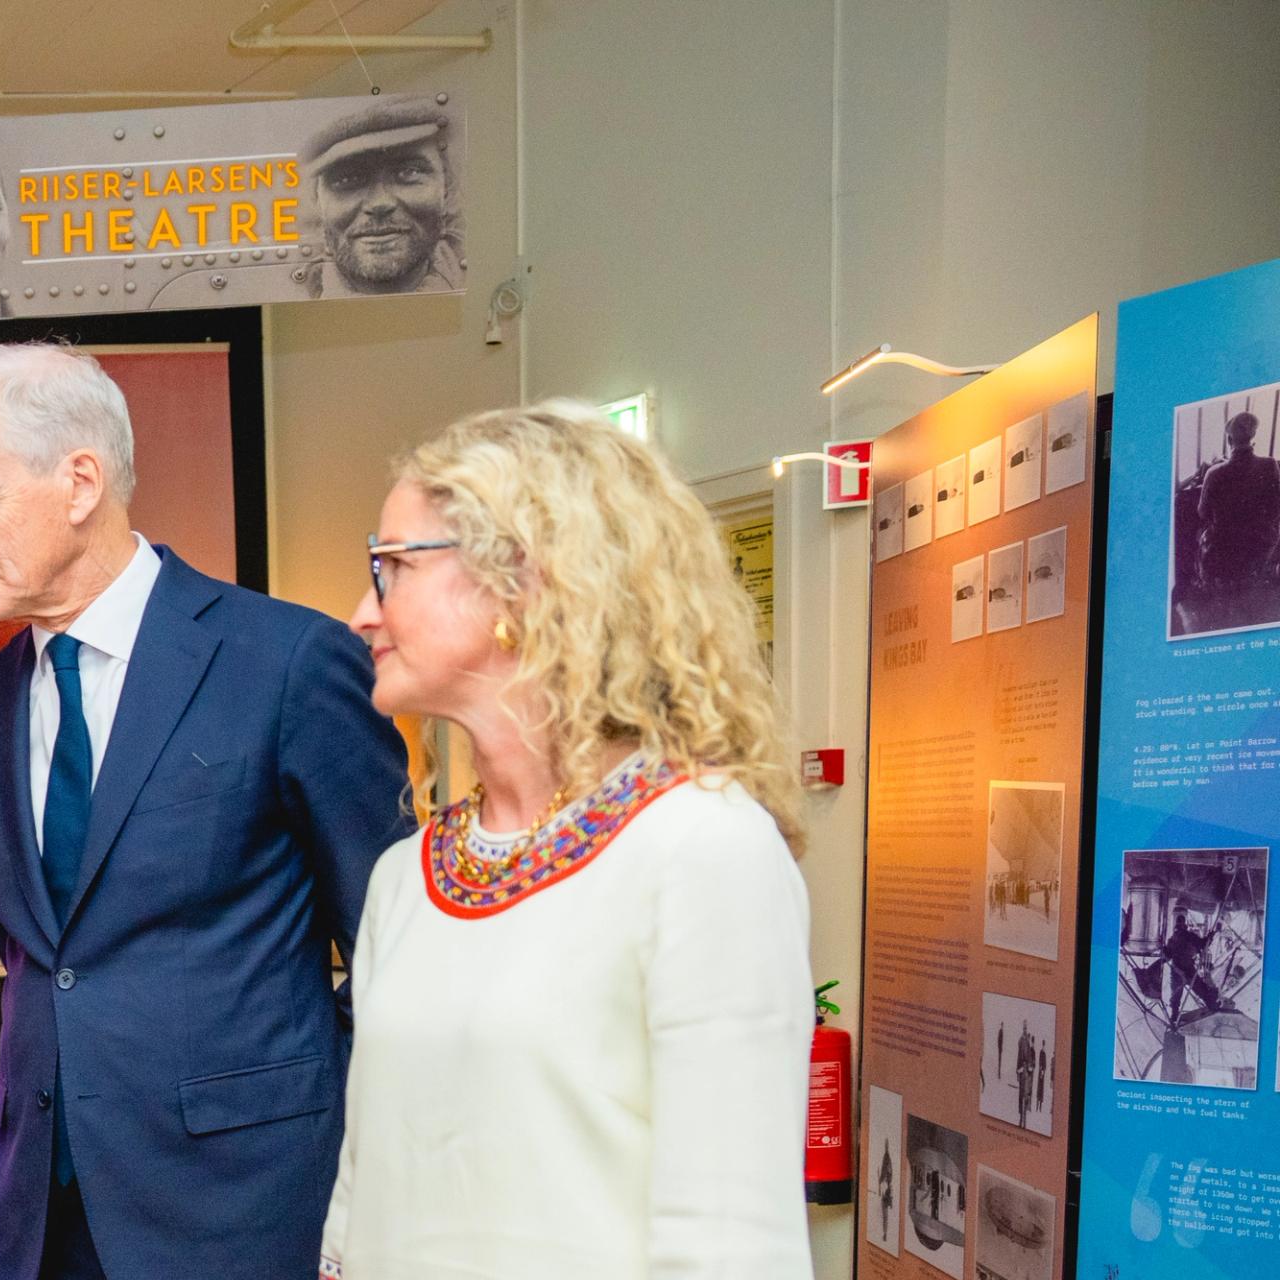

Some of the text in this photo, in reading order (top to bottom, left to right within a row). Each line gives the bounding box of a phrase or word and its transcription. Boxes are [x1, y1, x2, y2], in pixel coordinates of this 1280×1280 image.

[19, 160, 300, 204] RIISER-LARSEN'S
[20, 200, 300, 257] THEATRE
[884, 604, 920, 637] LEAVING
[1235, 643, 1245, 651] at
[1250, 641, 1265, 649] the
[883, 638, 929, 673] KINGS BAY
[1197, 693, 1211, 702] the
[1219, 739, 1242, 748] Point
[1248, 738, 1277, 746] Barrow
[1171, 755, 1180, 763] of
[1212, 763, 1235, 772] think
[1238, 761, 1257, 770] that
[1261, 761, 1275, 769] for
[1183, 778, 1193, 787] by
[1225, 857, 1234, 871] 5
[1150, 1092, 1193, 1105] inspecting
[1196, 1096, 1210, 1105] the
[1240, 1101, 1250, 1109] of
[1116, 1101, 1130, 1110] the
[1133, 1103, 1162, 1113] airship
[1166, 1106, 1180, 1114] and
[1183, 1107, 1196, 1116] the
[1200, 1109, 1218, 1118] fuel
[1171, 1161, 1184, 1170] The
[1222, 1167, 1237, 1176] bad
[1240, 1169, 1253, 1178] but
[1238, 1181, 1247, 1189] to
[1168, 1185, 1195, 1195] height
[1199, 1188, 1208, 1196] of
[1238, 1193, 1248, 1201] to
[1251, 1195, 1265, 1204] get
[1203, 1200, 1213, 1208] to
[1217, 1203, 1231, 1211] ice
[1211, 1213, 1234, 1224] icing
[1168, 1218, 1181, 1227] the
[1219, 1226, 1233, 1234] and
[1236, 1229, 1250, 1237] got
[1255, 1231, 1274, 1240] into
